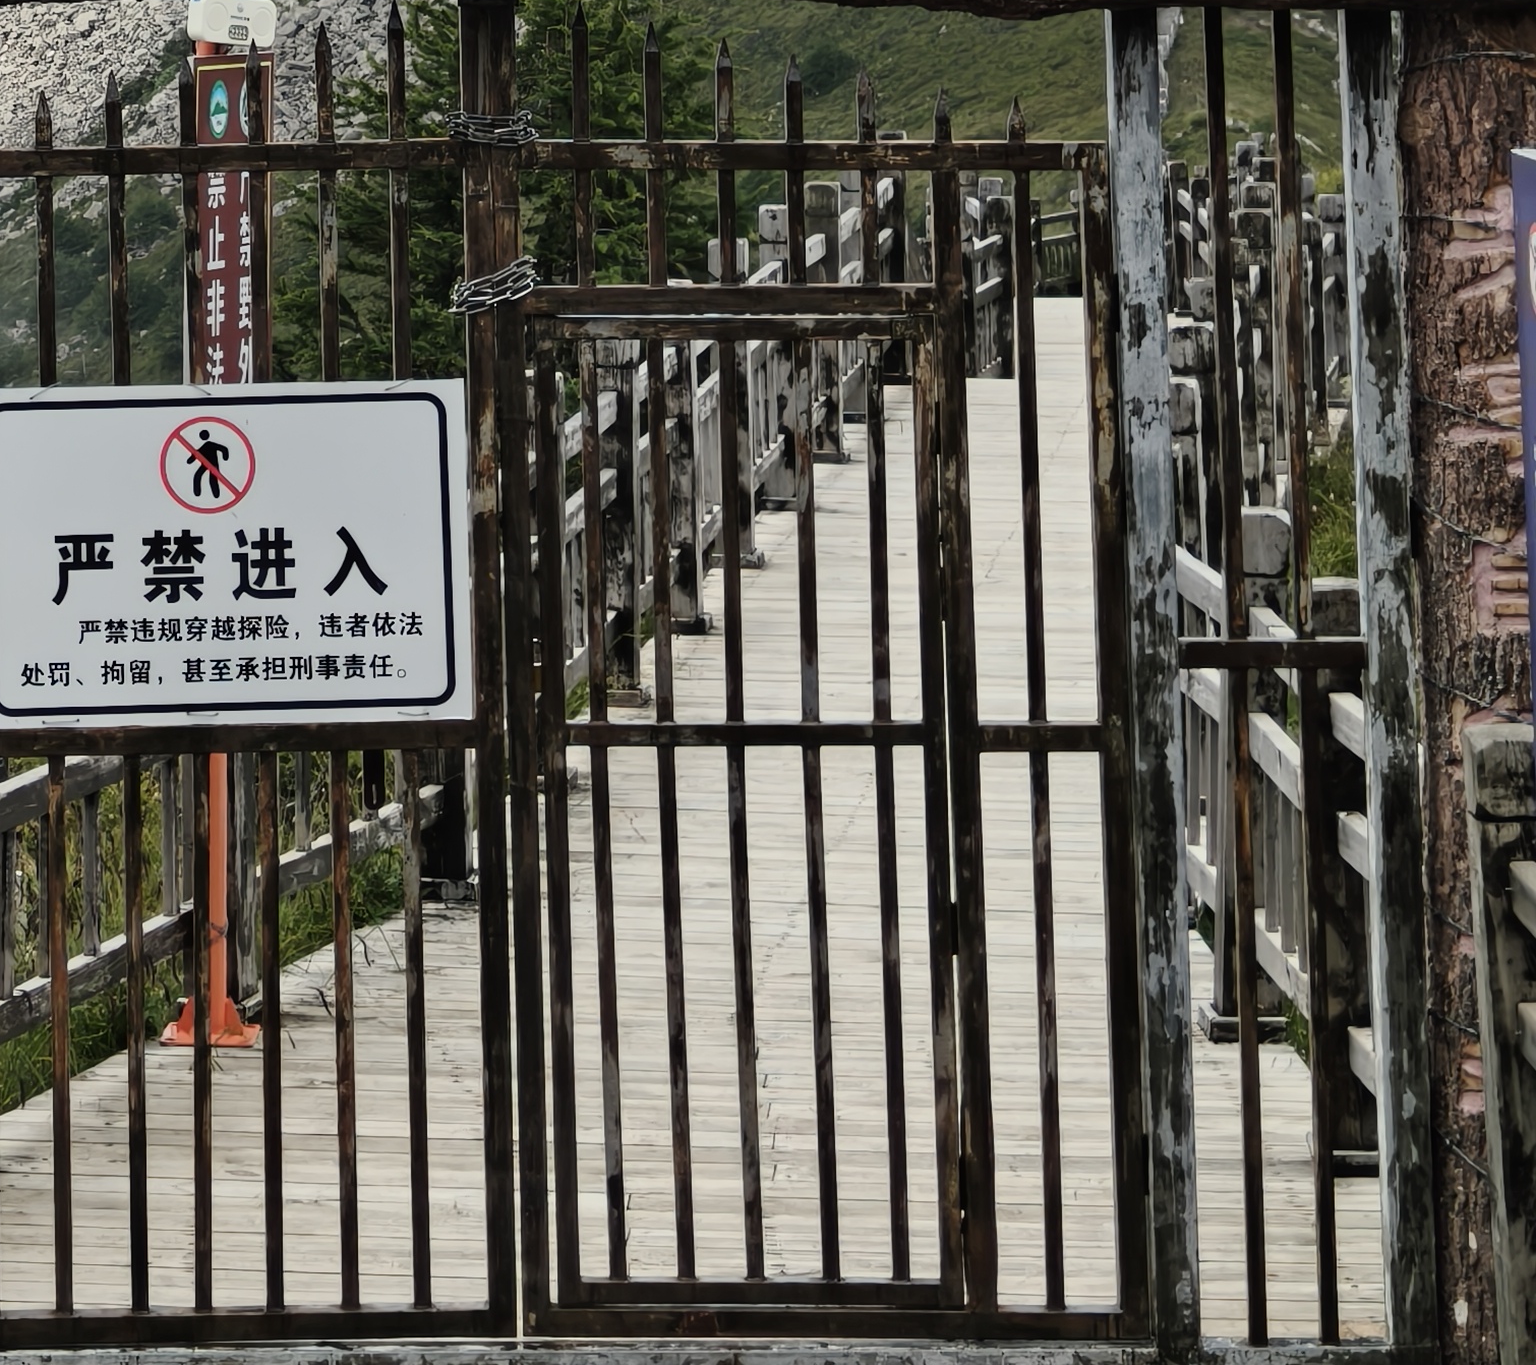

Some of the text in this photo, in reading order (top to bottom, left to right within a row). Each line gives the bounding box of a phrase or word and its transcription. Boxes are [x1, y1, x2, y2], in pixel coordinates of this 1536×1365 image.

[51, 525, 389, 605] 严禁进入
[77, 612, 424, 645] 严禁违规穿越探险，违者依法
[20, 655, 409, 687] 处罚、拘留，甚至承担刑事责任。
